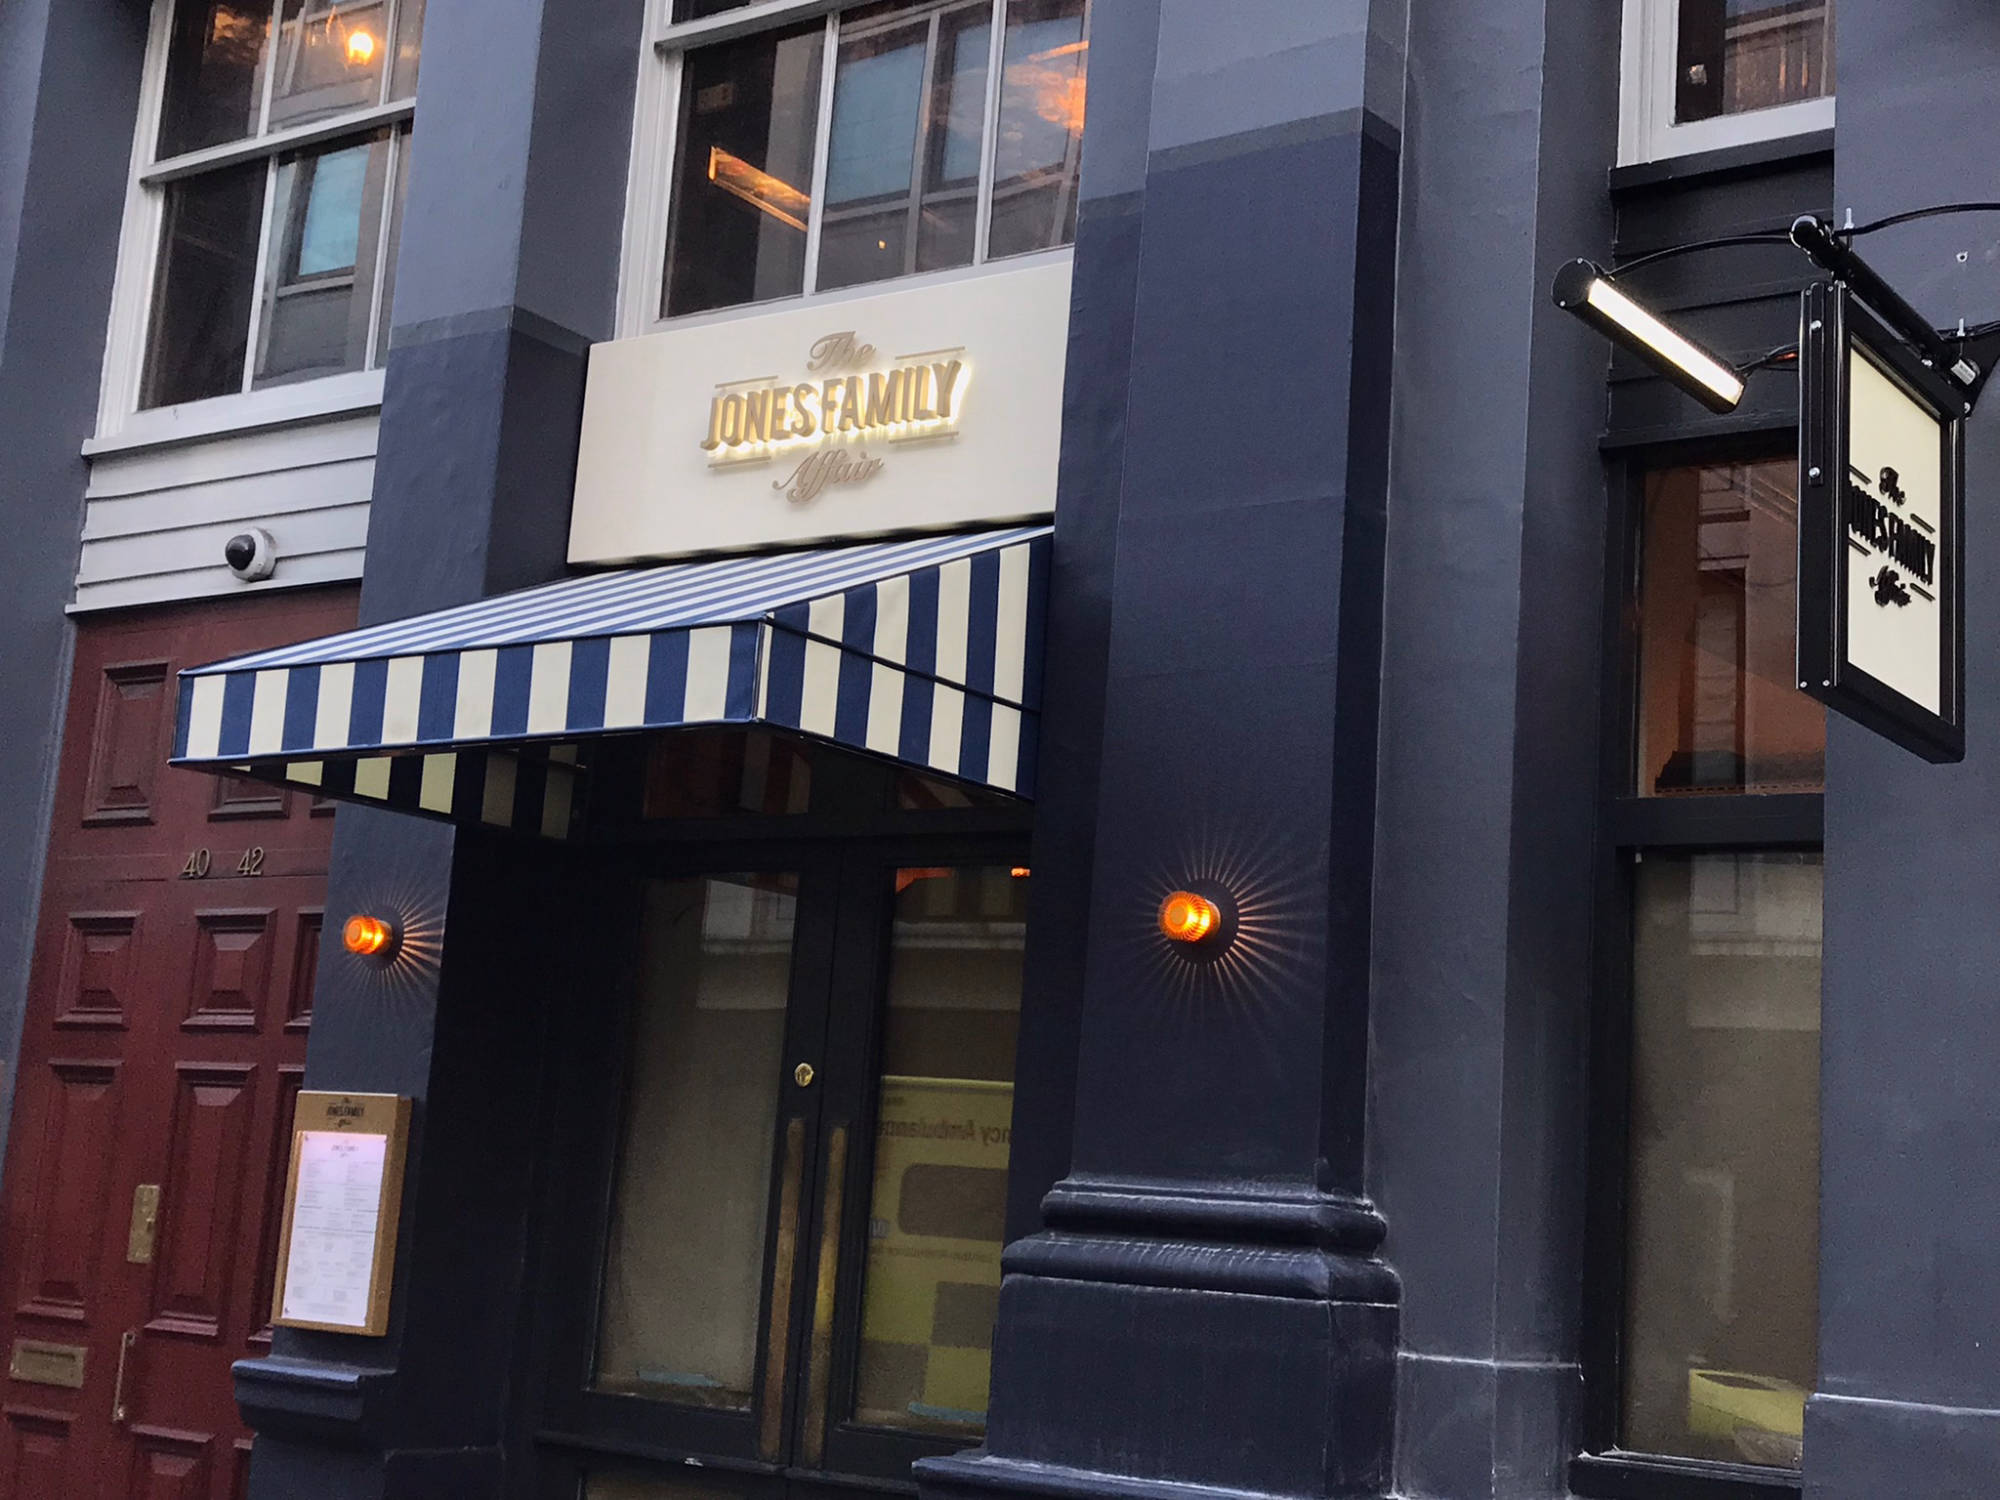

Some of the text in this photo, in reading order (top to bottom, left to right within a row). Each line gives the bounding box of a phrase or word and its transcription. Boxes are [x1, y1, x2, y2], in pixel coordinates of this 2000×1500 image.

[807, 330, 877, 371] The
[701, 360, 962, 450] JONES FAMILY
[772, 448, 884, 503] Affair
[182, 846, 264, 877] 40 42
